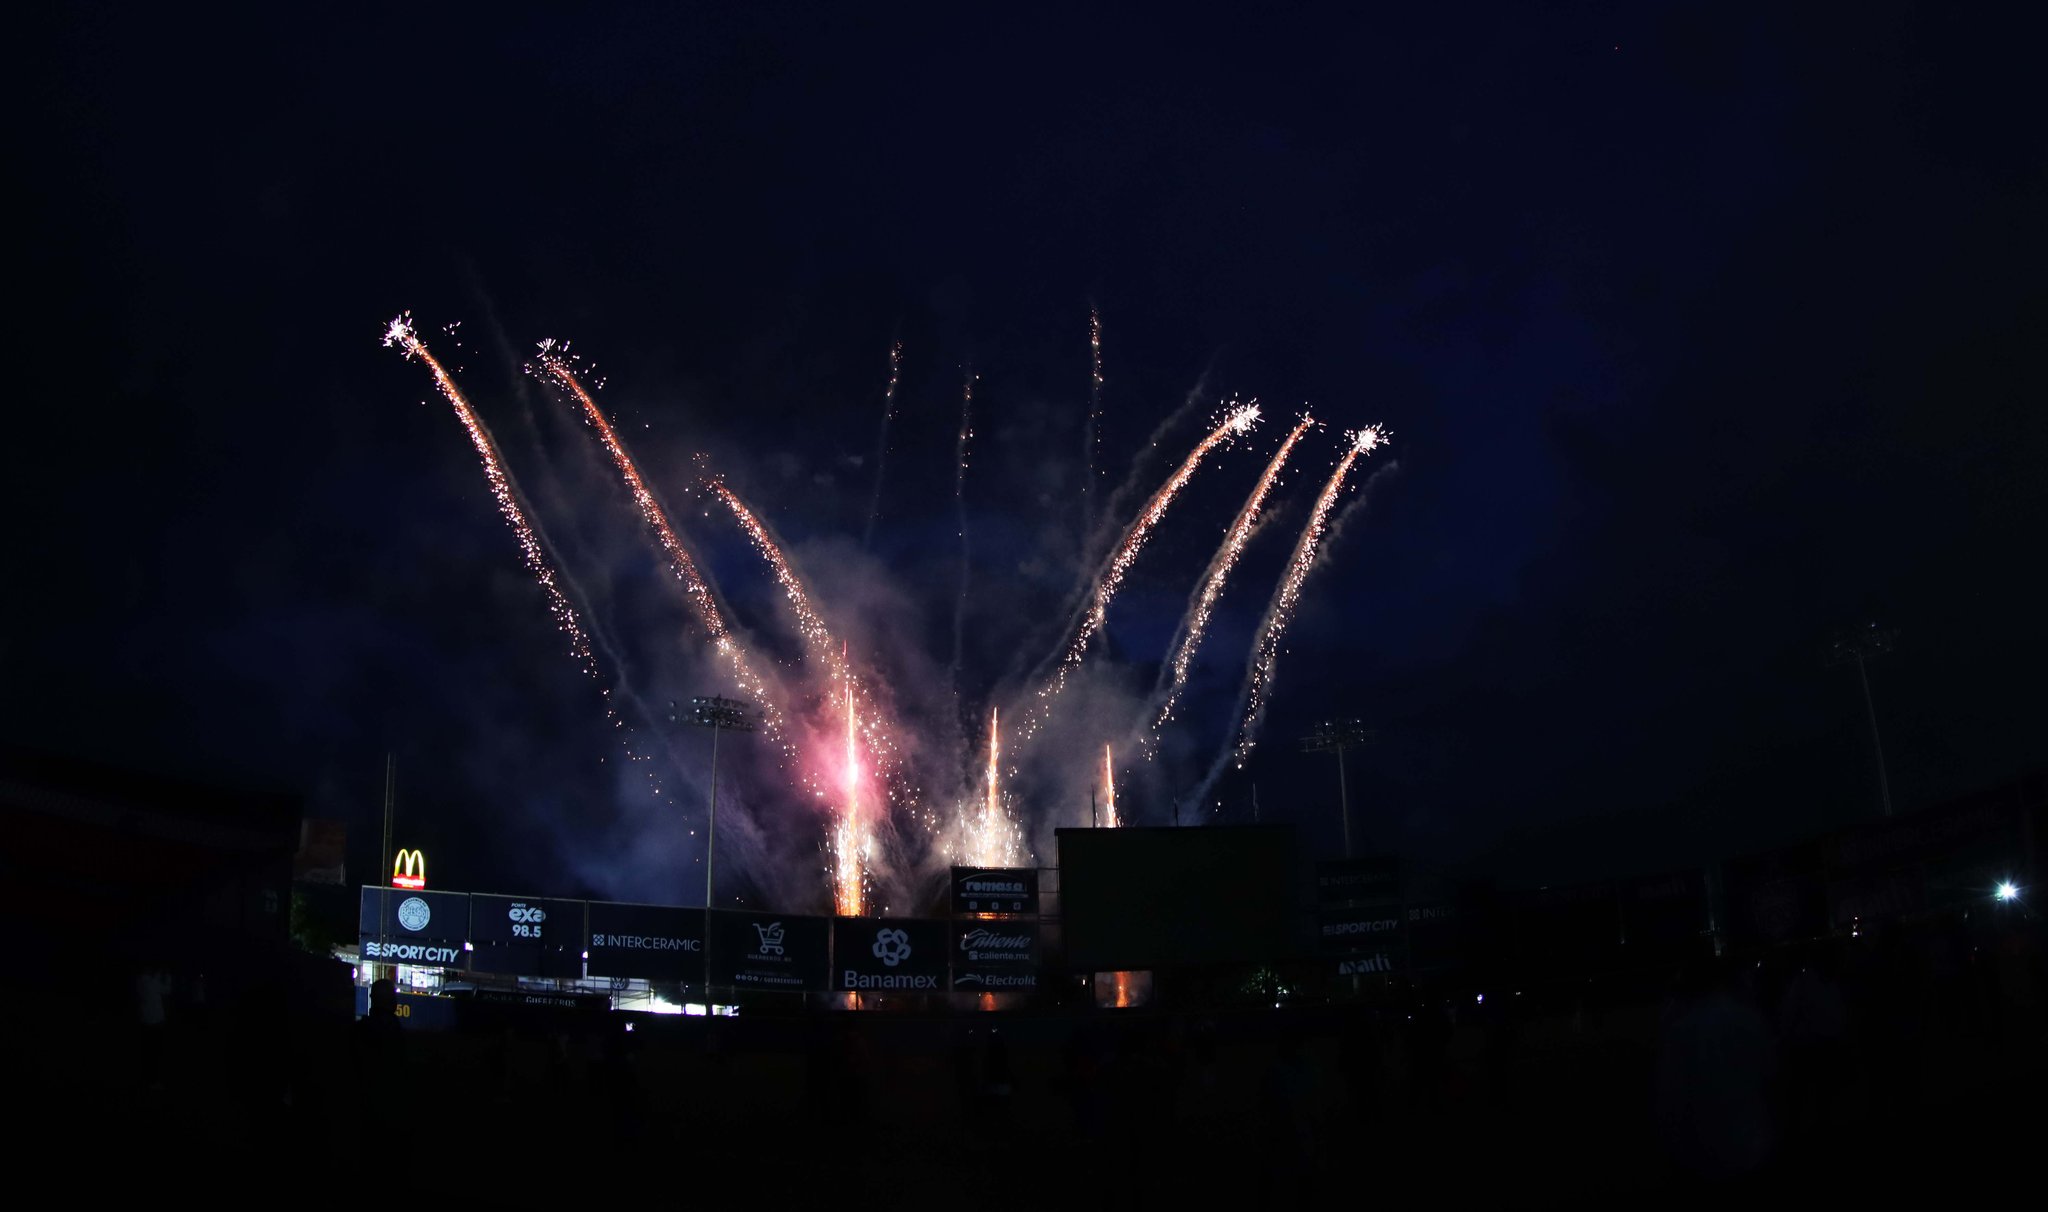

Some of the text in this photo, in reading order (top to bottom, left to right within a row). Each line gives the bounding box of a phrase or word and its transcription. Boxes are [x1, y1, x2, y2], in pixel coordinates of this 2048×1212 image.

[512, 924, 542, 938] 98.5
[607, 934, 701, 952] INTERCERAMIC
[960, 928, 1032, 951] Caliente
[979, 951, 1030, 961] caliente.mx
[844, 970, 937, 988] Banamex
[985, 974, 1037, 986] Electrolit
